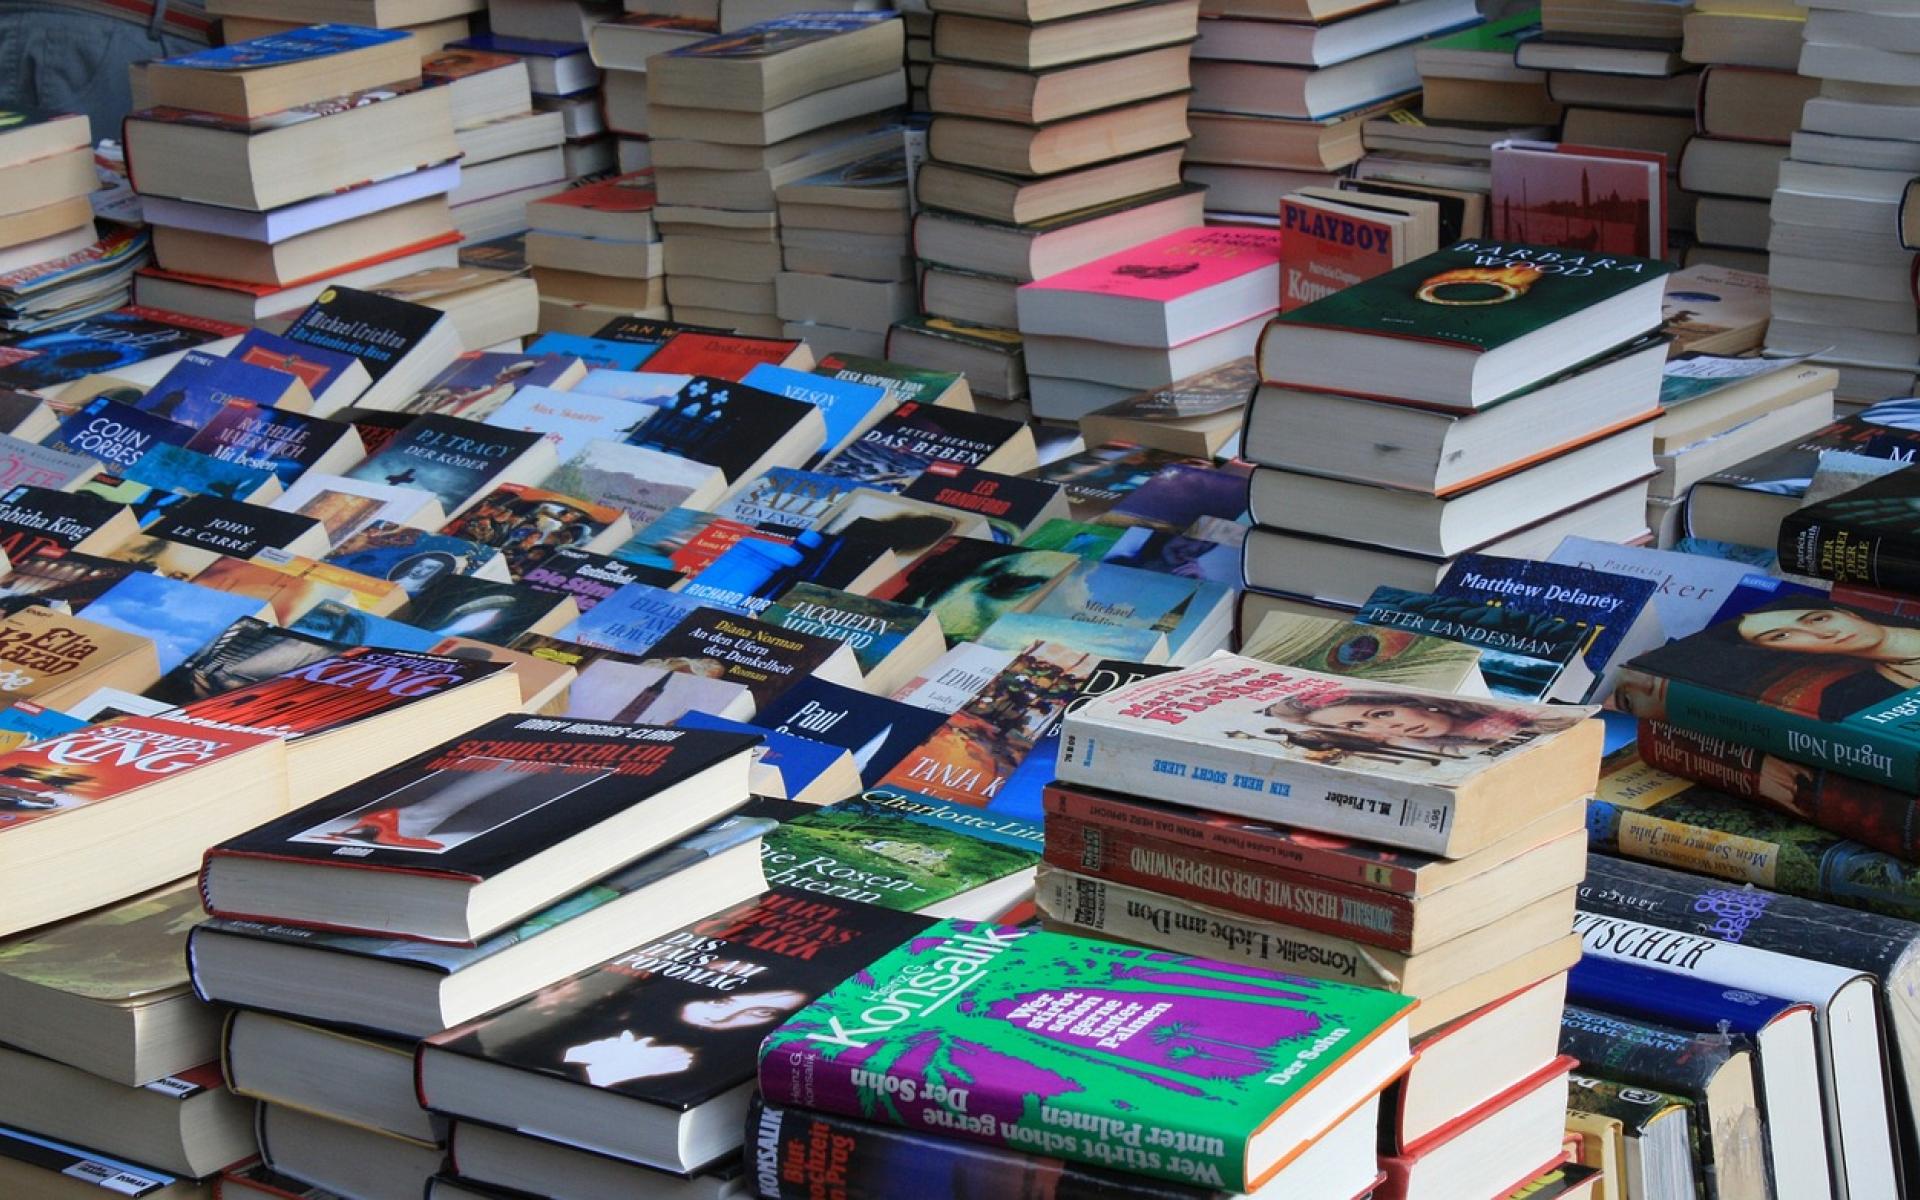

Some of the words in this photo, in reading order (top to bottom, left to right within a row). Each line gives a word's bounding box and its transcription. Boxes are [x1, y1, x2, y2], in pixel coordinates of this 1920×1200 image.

[1285, 204, 1389, 254] PLAYBOY
[1454, 242, 1645, 274] BARBARA
[1474, 254, 1595, 278] WOOD
[307, 311, 356, 340] Michael
[354, 323, 407, 350] Crichton
[783, 385, 839, 408] NELSON
[88, 418, 151, 449] COLIN
[237, 417, 311, 445] ROCHELLE
[443, 434, 515, 459] TRACY
[898, 425, 938, 441] PETER
[943, 433, 995, 453] HERNON
[70, 430, 144, 467] FORBES
[403, 444, 435, 461] DER
[435, 450, 489, 472] KÖDER
[863, 430, 905, 451] DAS
[909, 439, 987, 465] BEBEN
[934, 488, 1014, 516] STANDIFORD
[972, 479, 1000, 497] LES
[45, 515, 92, 541] King
[172, 525, 194, 538] LE
[196, 531, 257, 552] CARRÉ
[204, 518, 256, 536] JOHN
[1603, 559, 1663, 578] Patricia
[1822, 539, 1834, 572] DER
[686, 582, 744, 605] RICHARD
[1460, 571, 1543, 599] Matthew
[1544, 583, 1625, 614] Delaney
[785, 600, 891, 637] JACQUELYN
[1081, 598, 1137, 620] Michael
[27, 627, 98, 662] Elia
[688, 626, 708, 640] An
[707, 631, 734, 647] den
[732, 638, 770, 657] Ufern
[714, 619, 754, 638] Diana
[754, 628, 805, 652] Norman
[781, 616, 874, 650] MITCHARD
[1369, 607, 1426, 630] PETER
[1429, 618, 1559, 656] LANDESMAN
[357, 653, 467, 675] STEPHEN
[702, 644, 726, 659] der
[725, 649, 796, 677] Dunkelheit
[728, 664, 768, 683] Roman
[279, 657, 464, 697] KING
[785, 698, 849, 735] Paul
[16, 731, 203, 774] KING
[88, 725, 233, 761] STEPHEN
[1653, 739, 1692, 769] Lapid
[1786, 729, 1828, 761] Noll
[907, 755, 979, 793] TANJA
[1152, 758, 1188, 777] LIEBE
[1834, 741, 1893, 778] Ingrid
[1190, 768, 1229, 784] SUCHT
[1234, 775, 1264, 792] HERZ
[1269, 781, 1291, 798] EIN
[861, 789, 997, 830] Charlotte
[993, 821, 1045, 842] Lin
[1324, 790, 1364, 810] Fischer
[793, 855, 926, 893] Rosen-
[1130, 846, 1232, 896] STEPPENWIND
[1231, 871, 1264, 901] DER
[757, 893, 843, 922] MARY
[1264, 877, 1295, 909] WIE
[1295, 888, 1339, 918] HEISS
[1598, 888, 1664, 913] Janice
[1125, 900, 1172, 935] Don
[1174, 911, 1209, 934] am
[666, 932, 728, 953] DAS
[693, 916, 824, 960] CLARK
[1211, 915, 1271, 962] Liebe
[611, 954, 750, 992] POTOMAC
[645, 942, 719, 968] HAUS
[712, 958, 768, 977] AM
[1276, 936, 1358, 979] Konsalik
[806, 927, 1031, 1048] Konsalik
[861, 973, 907, 1003] Heinz
[1005, 993, 1056, 1021] Wer
[1027, 991, 1084, 1030] stirbt
[1047, 996, 1105, 1033] schon
[1068, 998, 1124, 1038] gerne
[1088, 1001, 1143, 1039] unter
[1096, 1002, 1174, 1049] Palmen
[1561, 1018, 1619, 1039] TAYLO
[1264, 1056, 1301, 1087] Der
[1298, 1027, 1352, 1063] Sohn
[849, 1067, 918, 1103] Sohn
[919, 1087, 970, 1113] Der
[921, 1106, 998, 1137] gerne
[1000, 1120, 1079, 1153] schon
[1040, 1105, 1144, 1146] Palmen
[757, 1105, 785, 1200] KONSALIK
[1080, 1137, 1161, 1171] stirbt
[1148, 1131, 1227, 1157] unter
[1186, 1157, 1226, 1188] Wer
